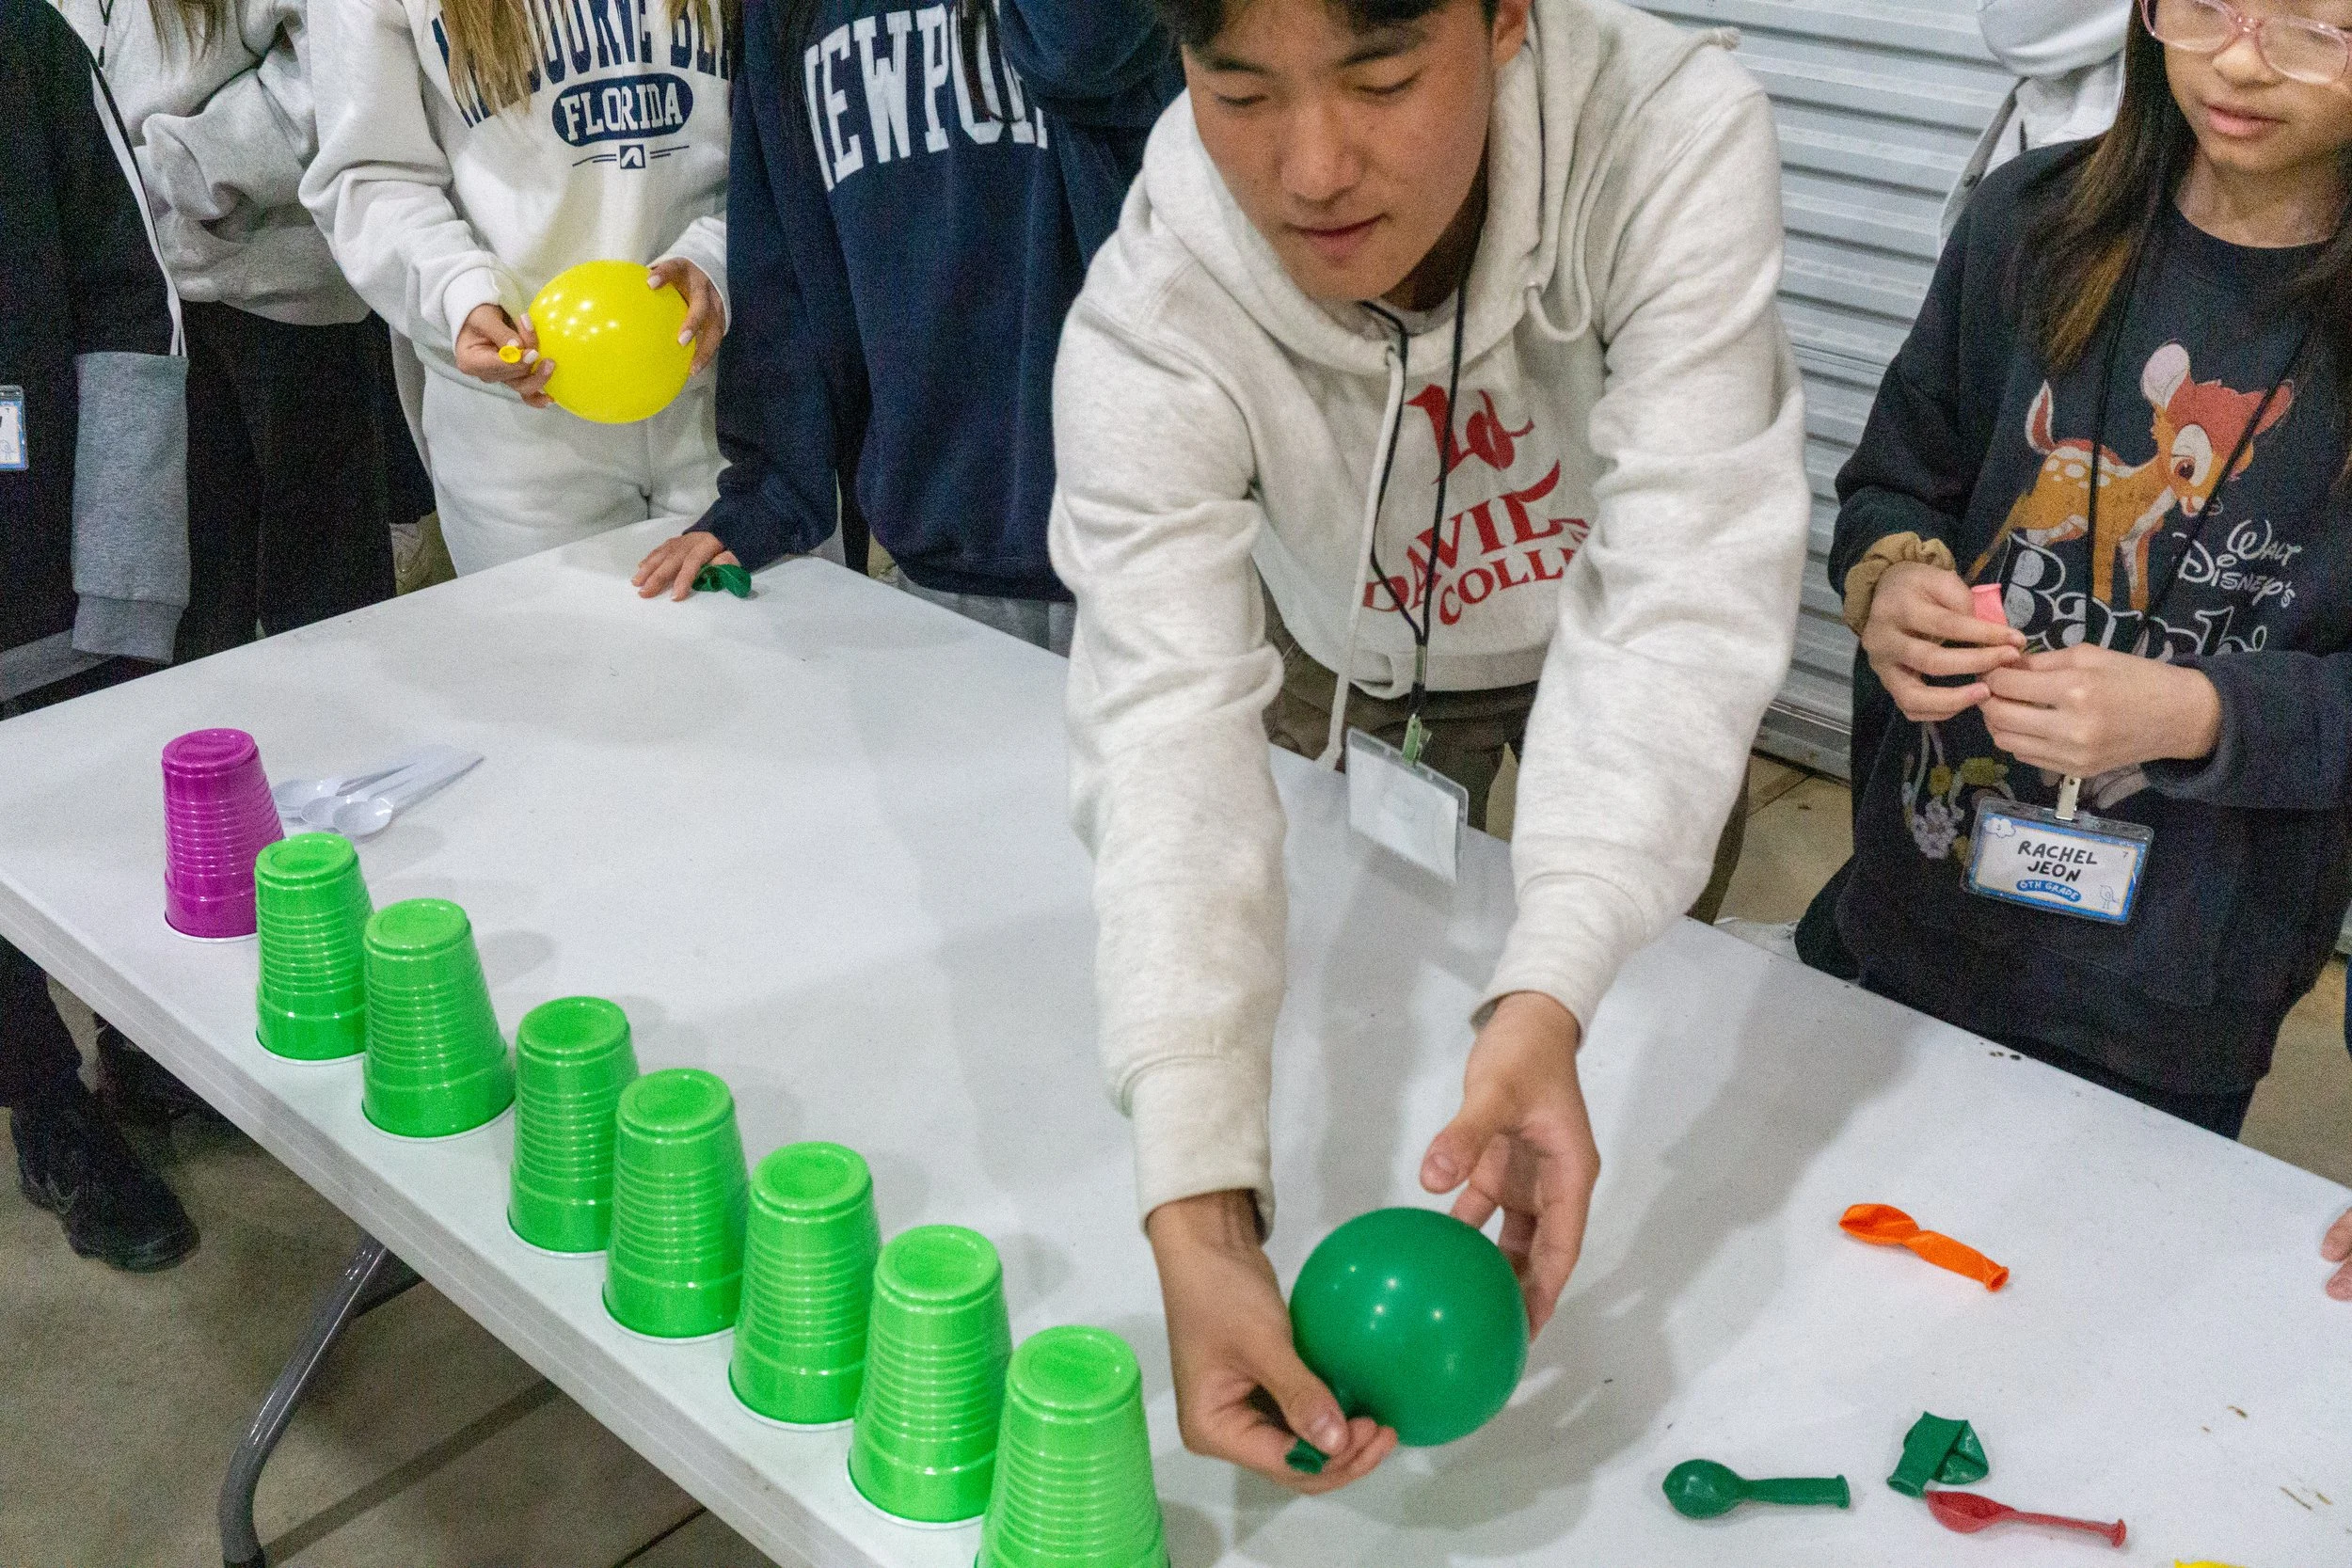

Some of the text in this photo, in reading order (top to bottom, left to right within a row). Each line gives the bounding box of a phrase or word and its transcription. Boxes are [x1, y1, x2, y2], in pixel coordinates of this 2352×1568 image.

[560, 82, 683, 142] FLORIDA
[804, 3, 1047, 192] EWPO
[1362, 458, 1592, 612] DAVIL
[1438, 547, 1577, 626] COLL
[2017, 840, 2098, 865] RACHEL
[2027, 861, 2081, 882] JEON
[2122, 850, 2129, 859] 7
[2044, 881, 2078, 900] GRADE
